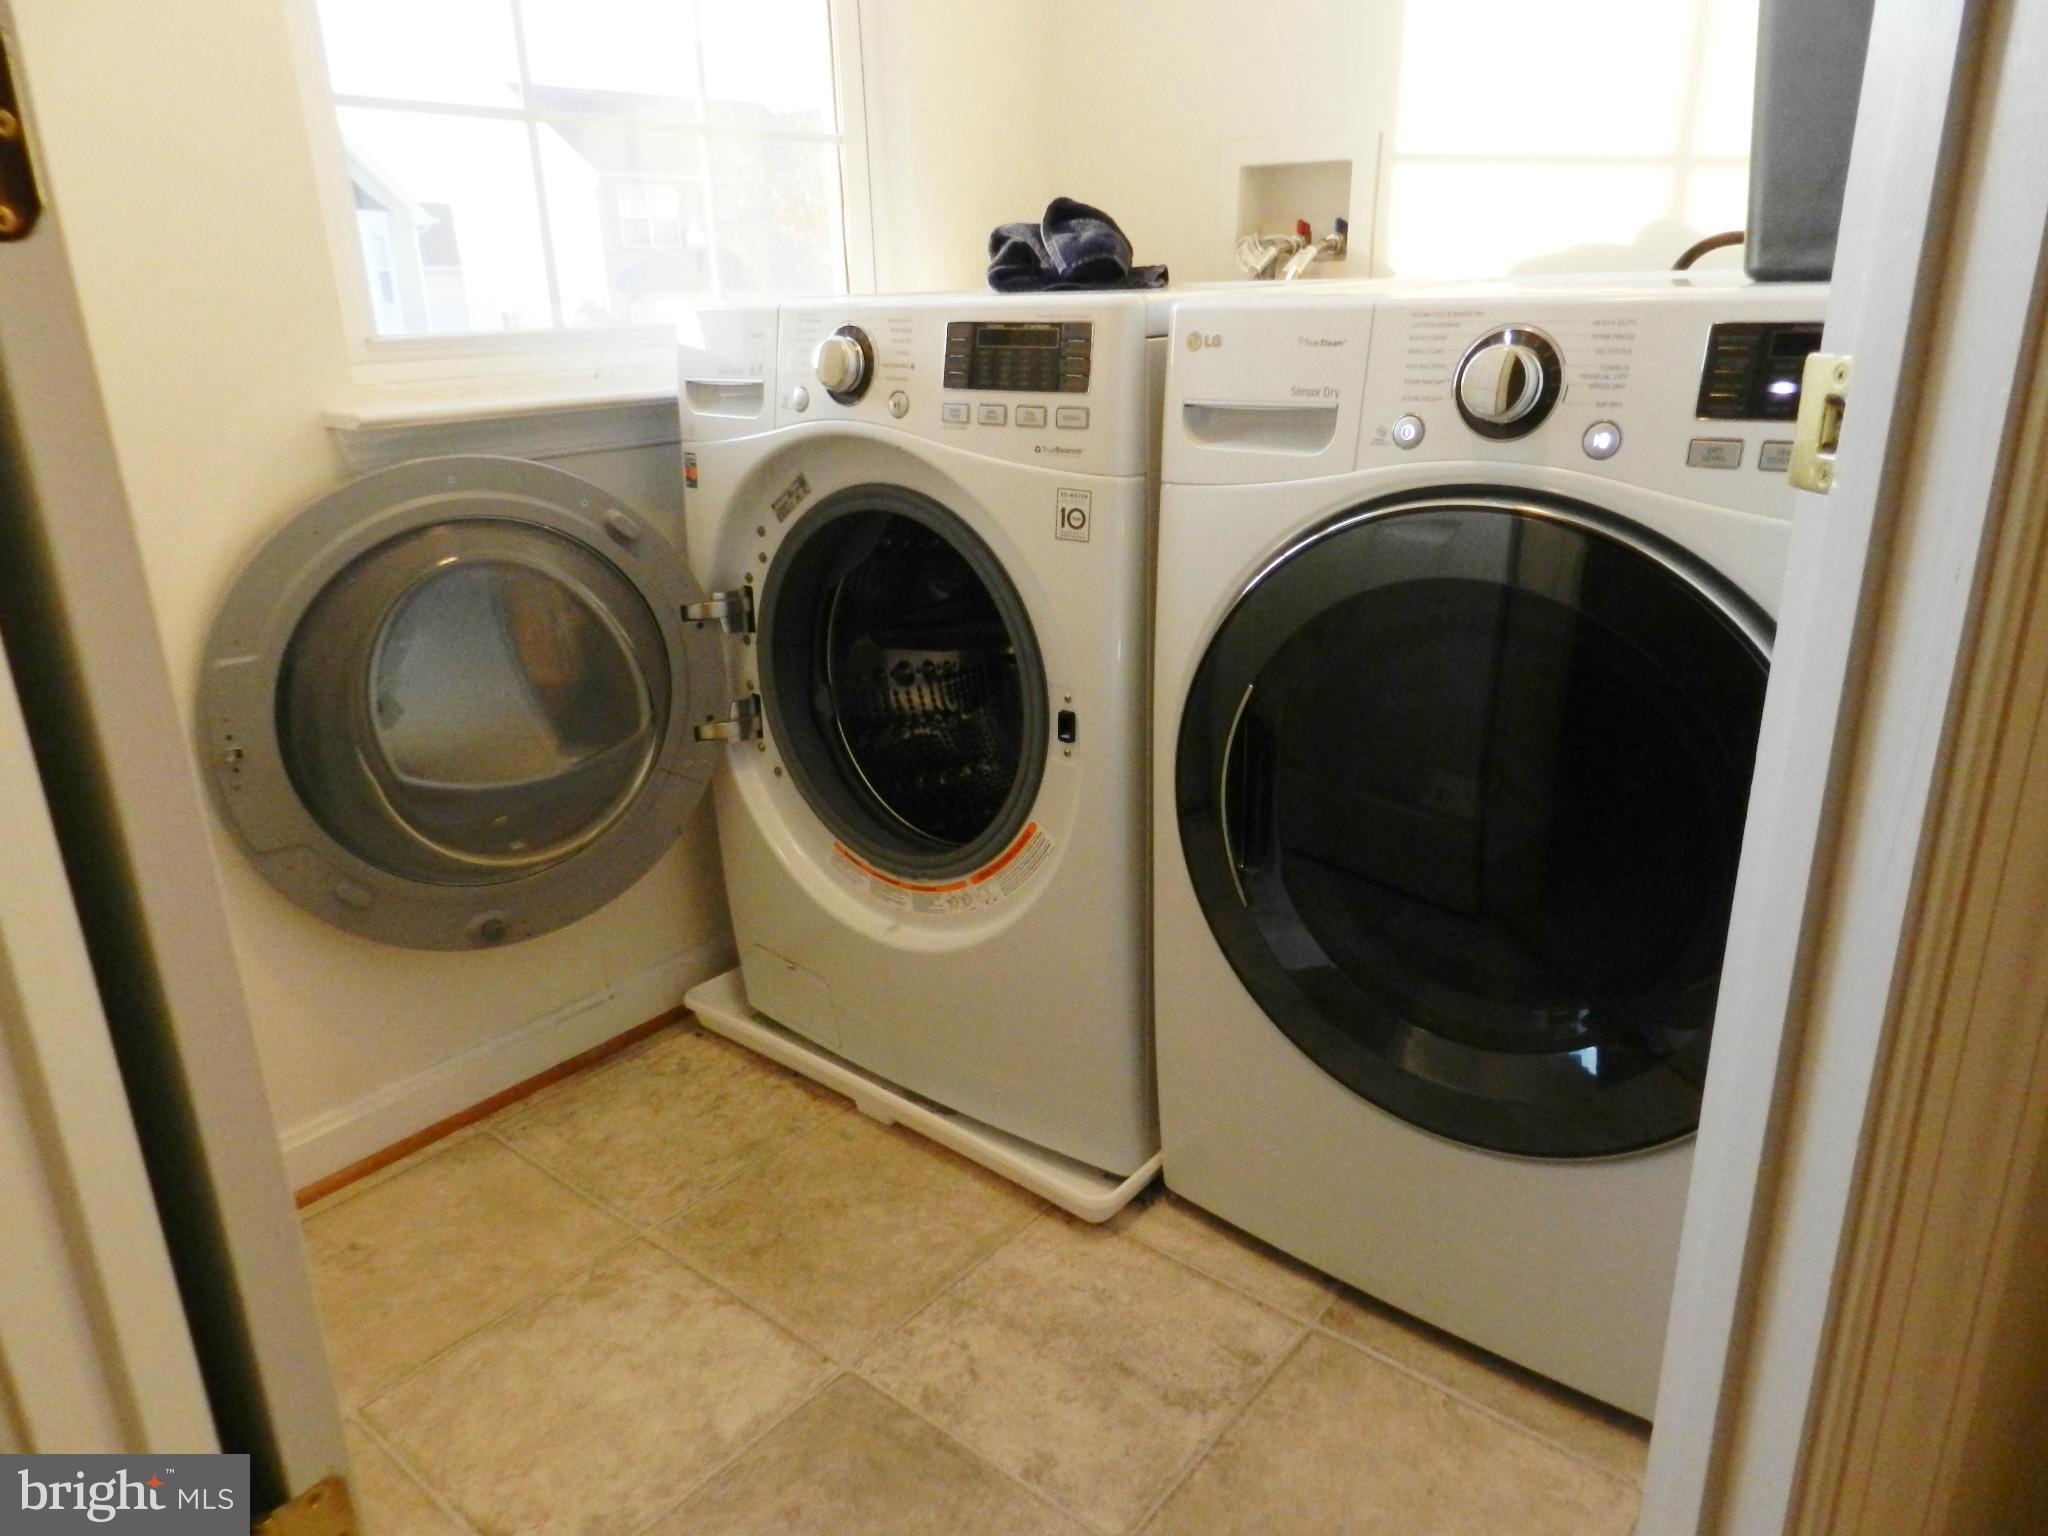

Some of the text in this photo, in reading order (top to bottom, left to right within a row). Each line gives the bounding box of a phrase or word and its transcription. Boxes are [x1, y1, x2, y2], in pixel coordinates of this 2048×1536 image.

[1204, 334, 1222, 348] LG
[1290, 385, 1340, 399] Sensor Dry
[1060, 506, 1087, 530] 10
